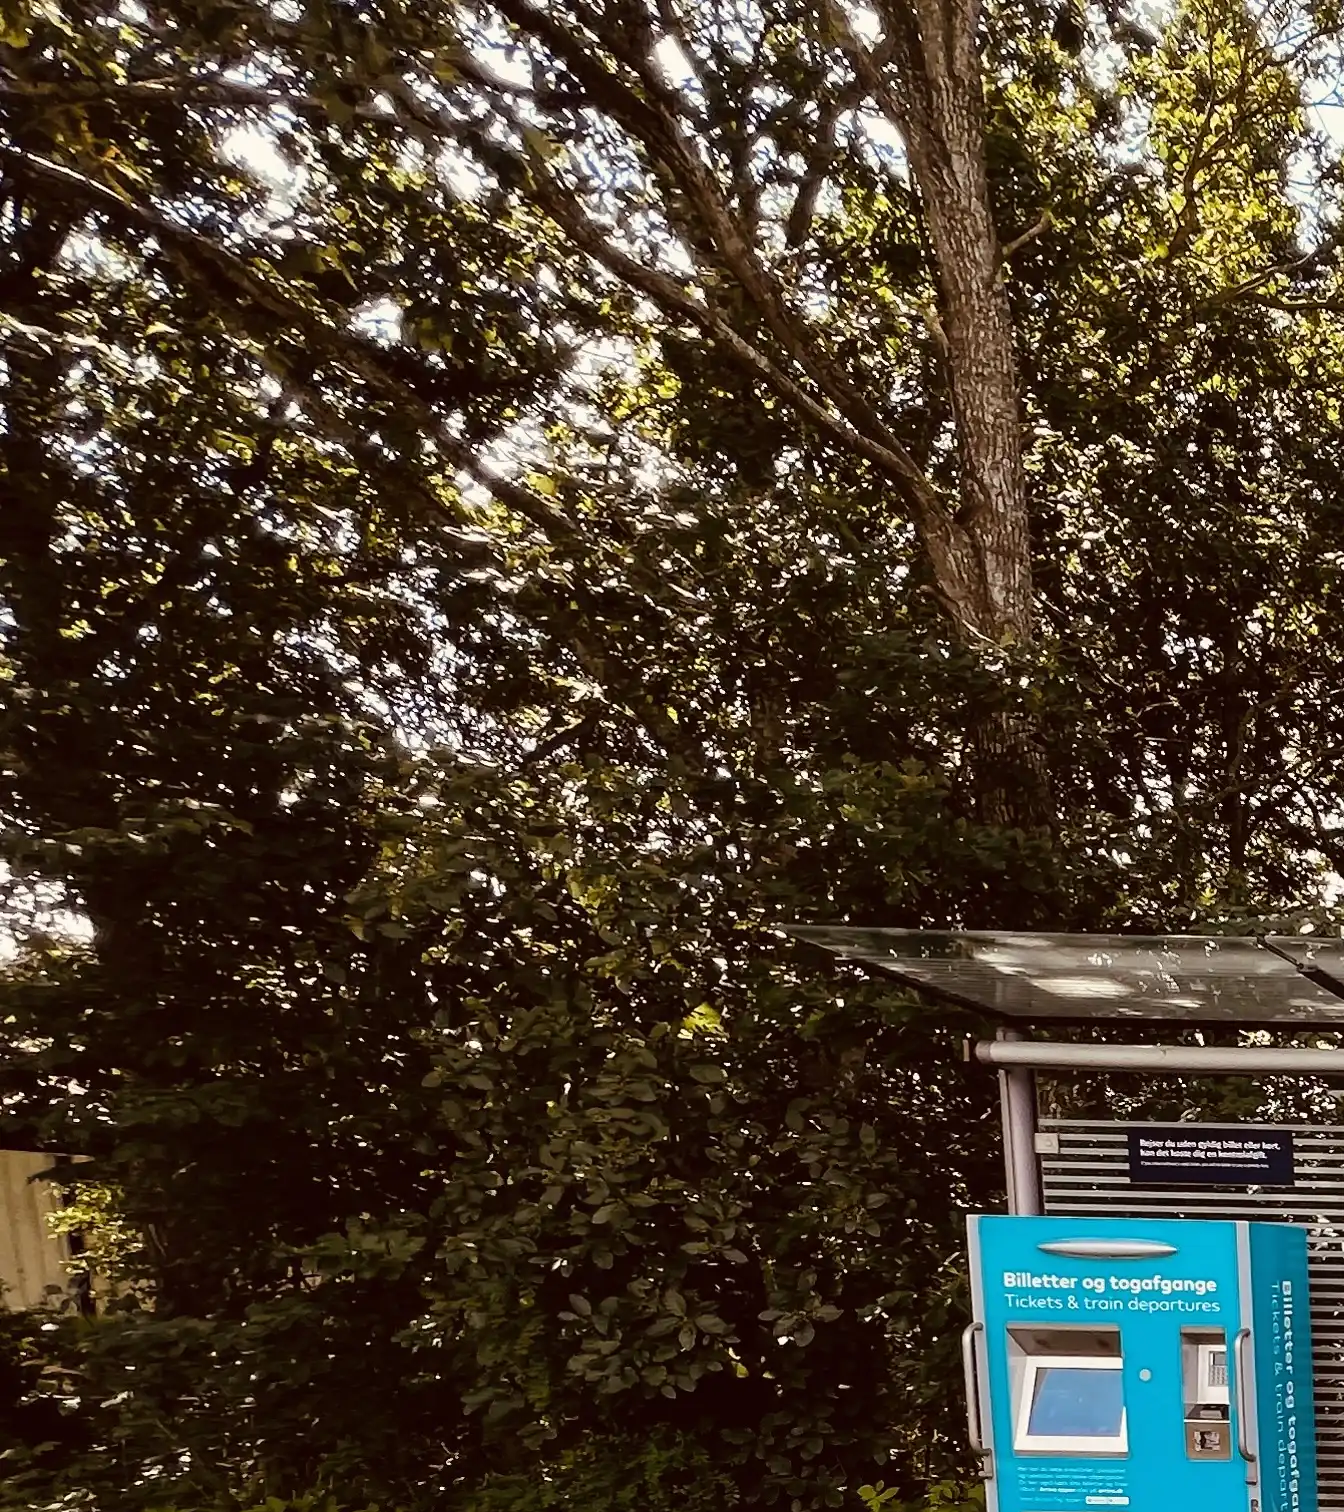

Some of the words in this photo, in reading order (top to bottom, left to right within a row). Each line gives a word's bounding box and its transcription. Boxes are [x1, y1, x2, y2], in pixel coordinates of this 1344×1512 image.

[1003, 1272, 1078, 1289] Billetter
[1082, 1277, 1105, 1293] og
[1109, 1275, 1217, 1295] togafgange
[1004, 1293, 1063, 1309] Tickets
[1067, 1295, 1080, 1310] &
[1084, 1296, 1124, 1311] train
[1127, 1297, 1221, 1313] departures
[1271, 1280, 1281, 1355] Tickets
[1282, 1280, 1294, 1375] Billetter
[1274, 1383, 1285, 1433] train
[1285, 1381, 1295, 1409] og
